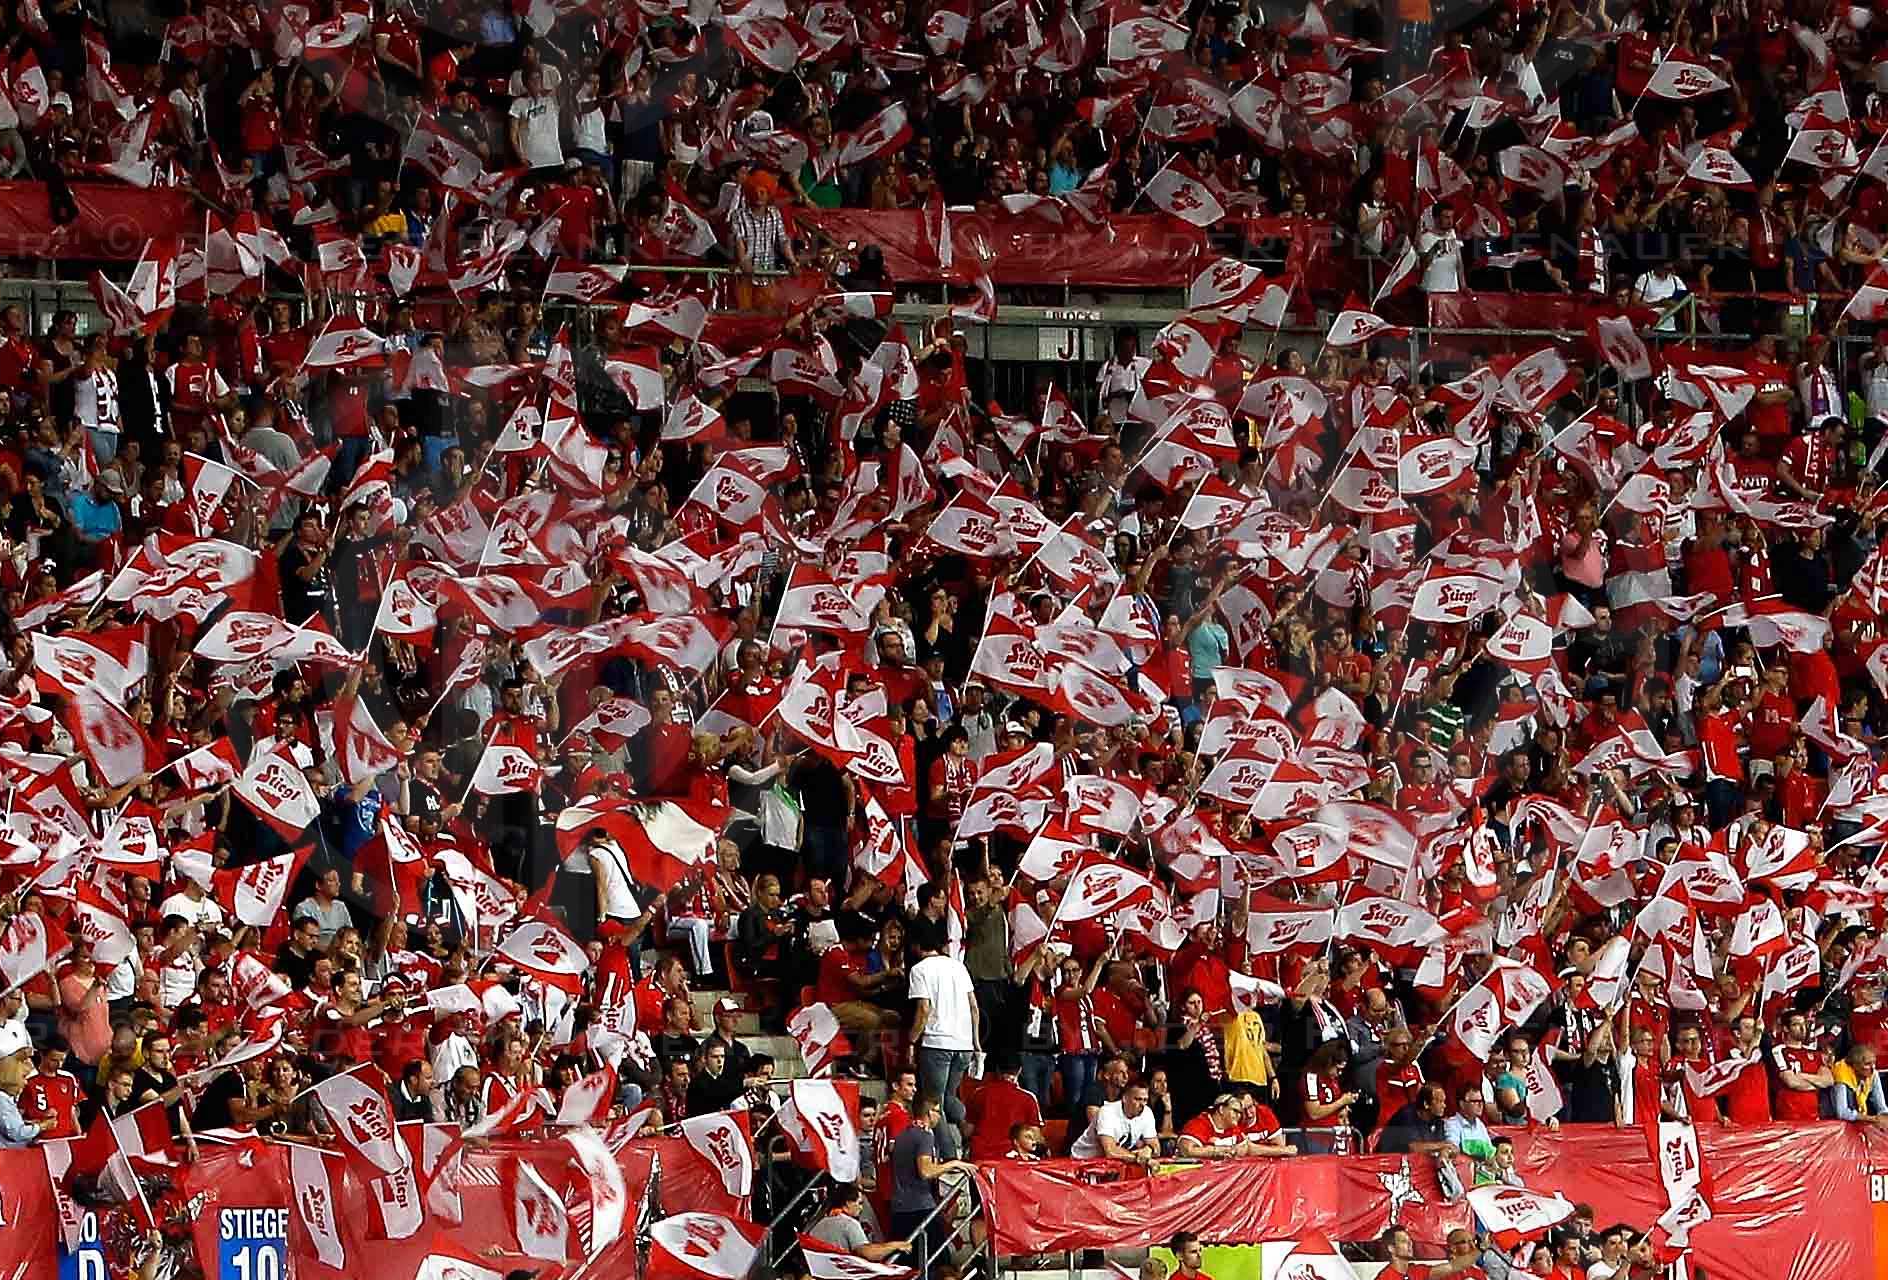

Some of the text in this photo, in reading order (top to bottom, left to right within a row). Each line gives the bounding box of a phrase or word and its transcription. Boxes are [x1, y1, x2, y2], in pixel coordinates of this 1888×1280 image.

[718, 477, 747, 503] Stiegl
[1440, 584, 1476, 605] Stiegl
[865, 742, 899, 776] Stiegl
[266, 762, 299, 799] Stiegl
[1366, 903, 1407, 929] Stiegl
[351, 1099, 389, 1140] Stiegl
[714, 1128, 739, 1168] Stiegl
[220, 1207, 289, 1241] STIEGE
[309, 1185, 331, 1234] Stiegl
